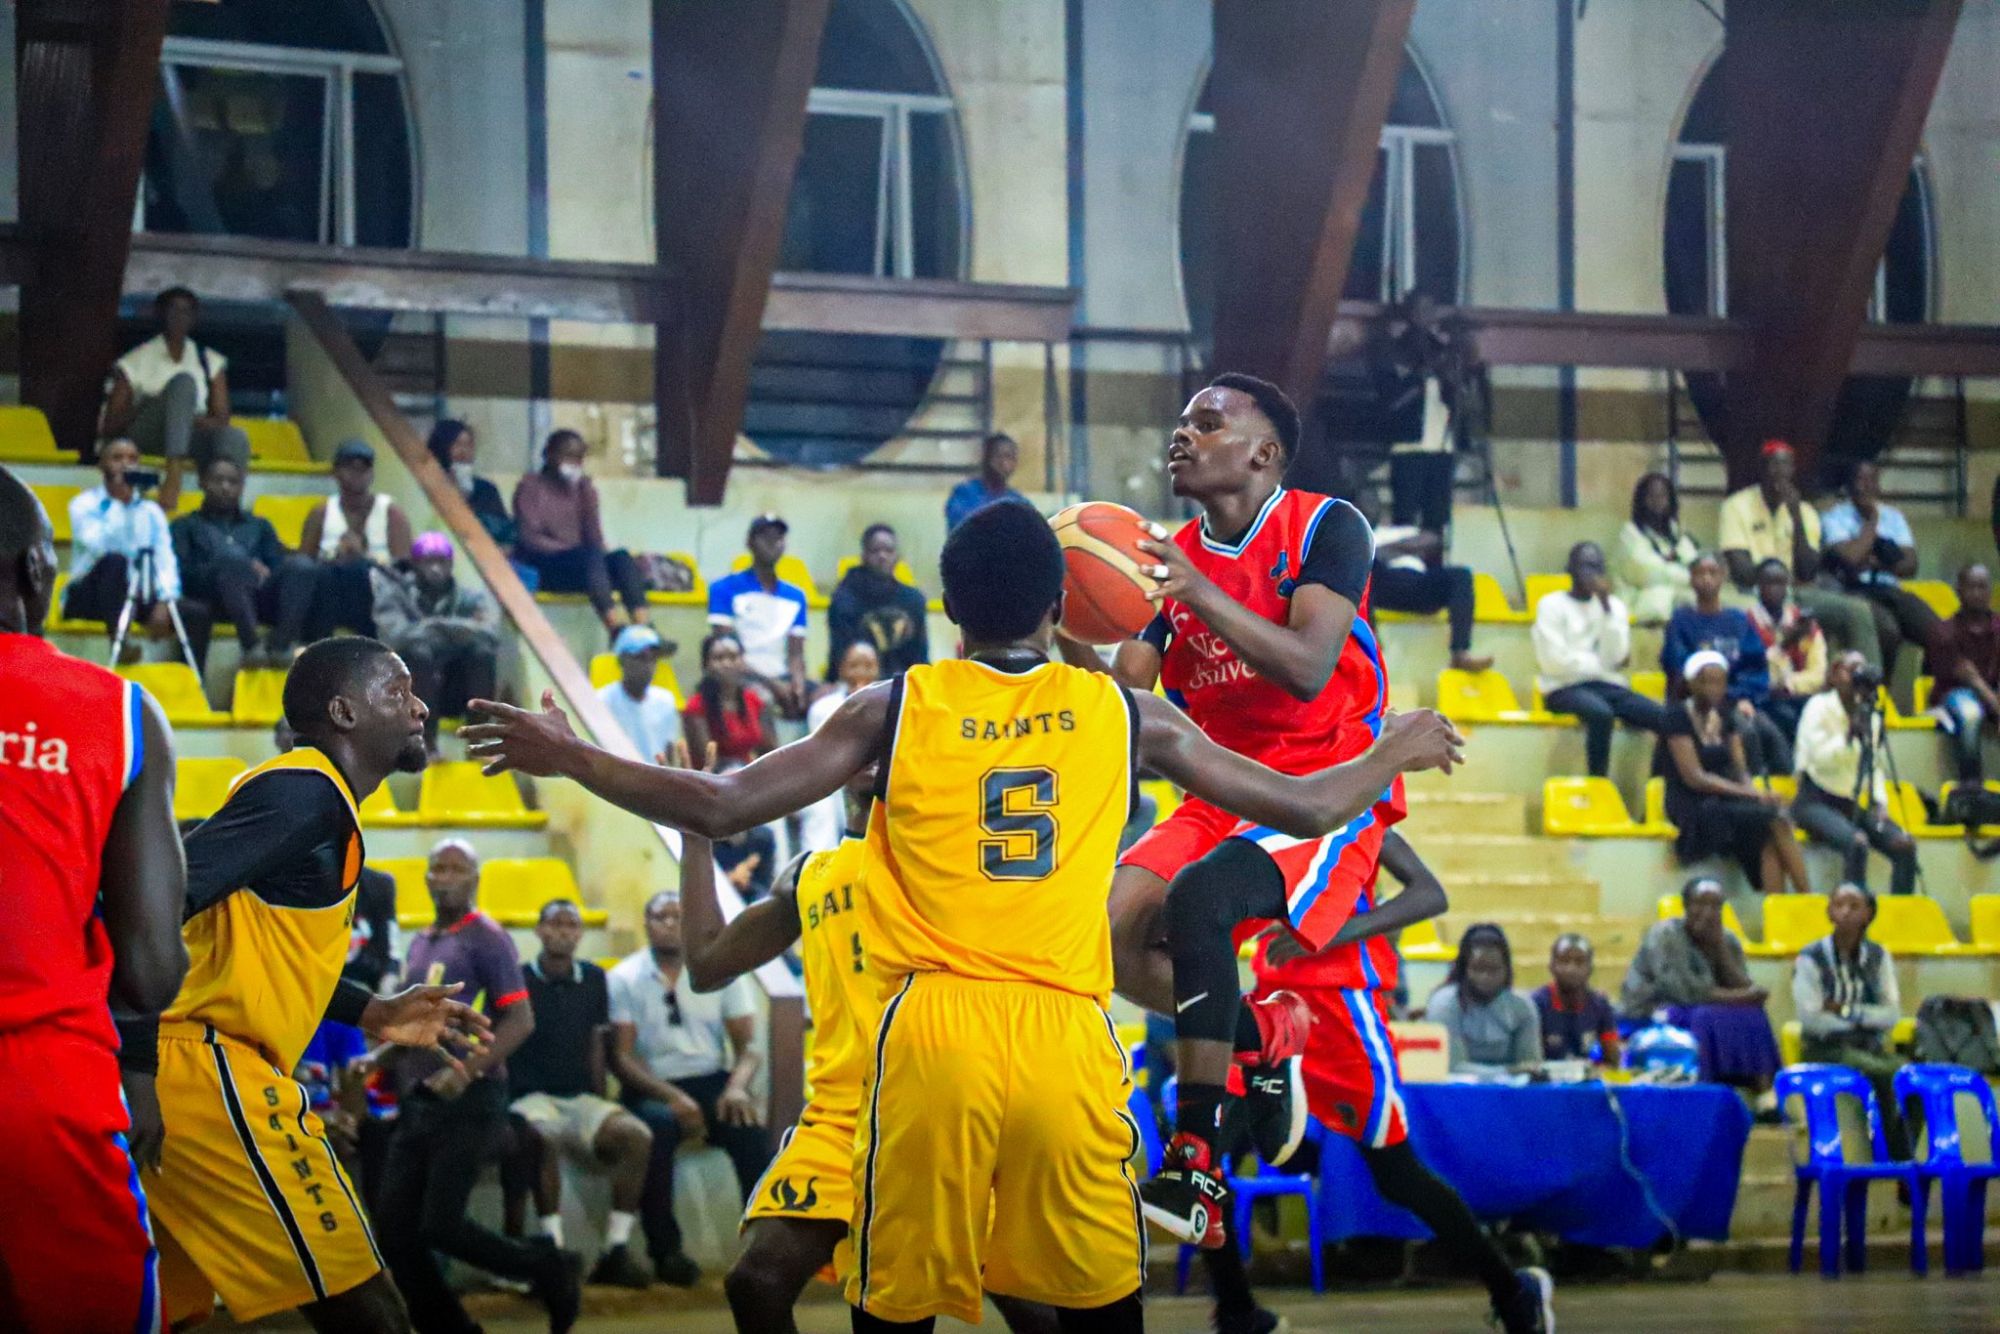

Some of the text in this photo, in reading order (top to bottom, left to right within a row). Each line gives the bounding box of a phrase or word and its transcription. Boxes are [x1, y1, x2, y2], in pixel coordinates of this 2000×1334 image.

[1187, 632, 1228, 659] Vic
[0, 721, 69, 775] ria
[961, 710, 1076, 741] SAINTS
[808, 882, 854, 931] SAI
[263, 1086, 338, 1232] SAINTS
